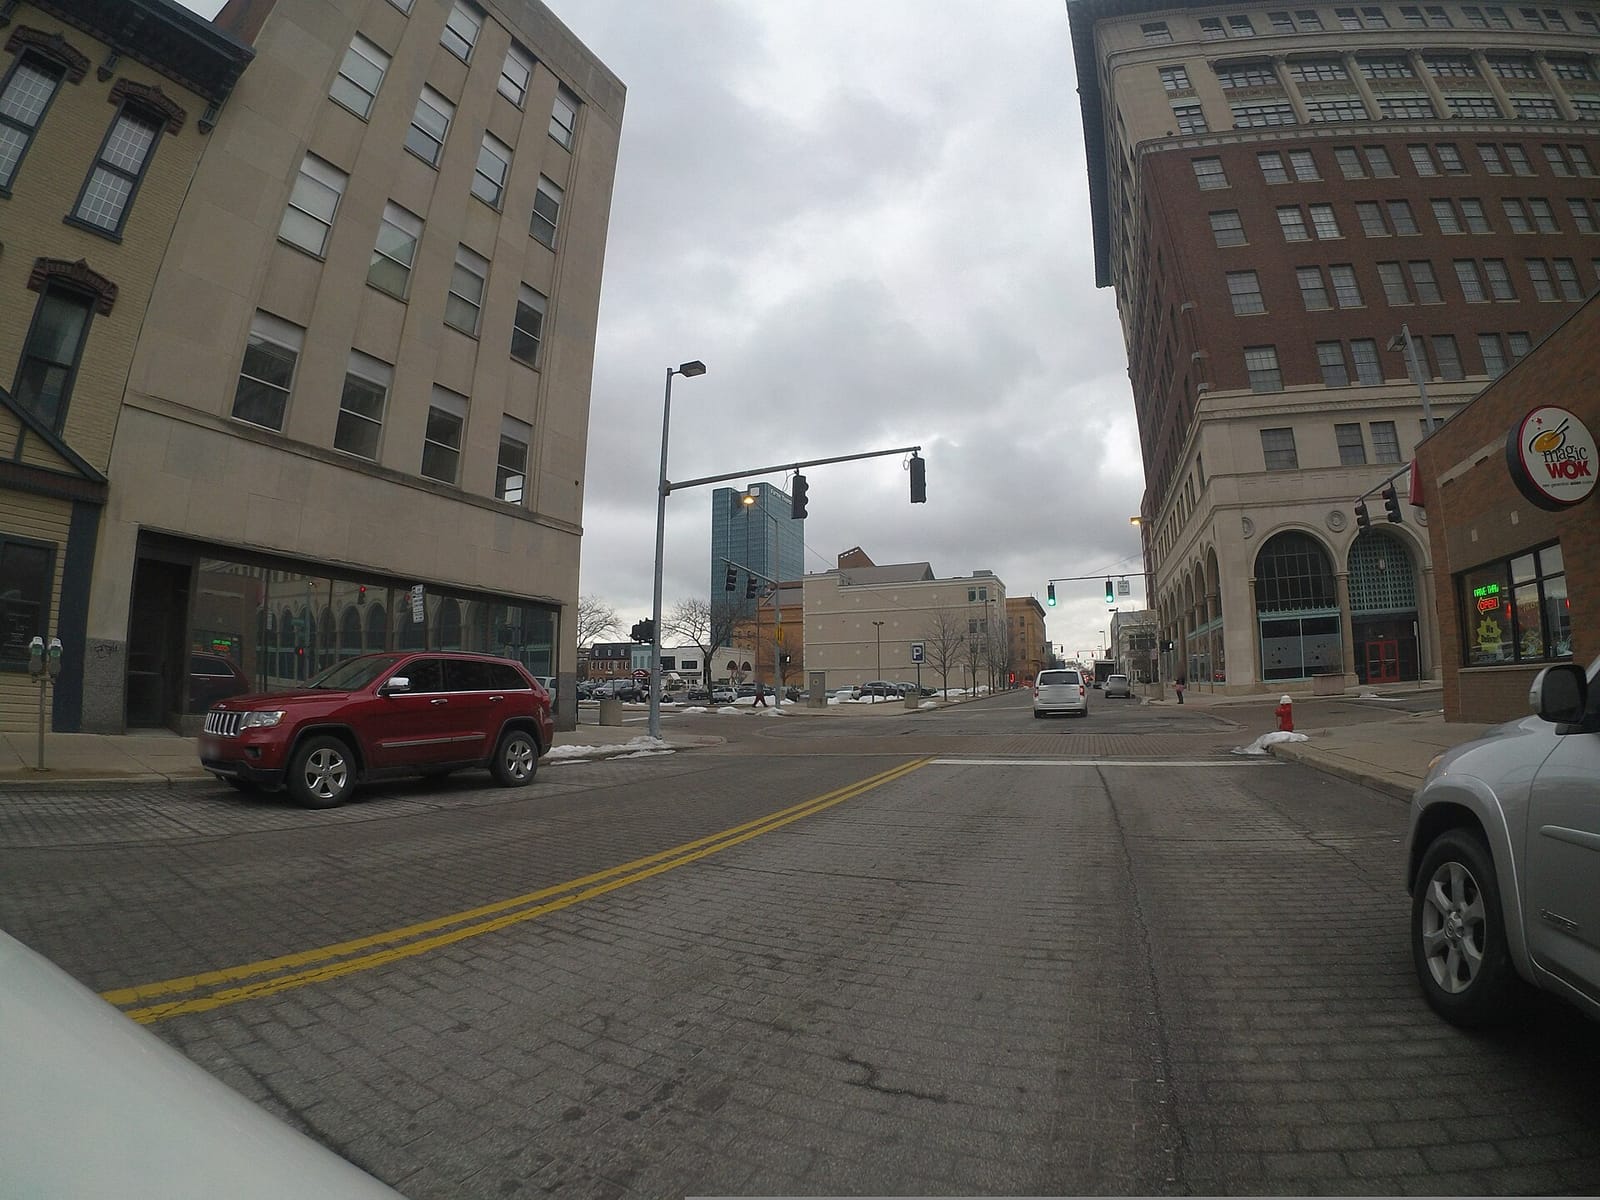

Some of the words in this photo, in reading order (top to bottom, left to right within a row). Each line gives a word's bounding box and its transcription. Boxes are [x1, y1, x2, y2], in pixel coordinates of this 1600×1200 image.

[1541, 445, 1588, 462] magic
[1545, 460, 1591, 479] WOK
[1480, 599, 1497, 610] OPEN
[913, 647, 922, 659] P
